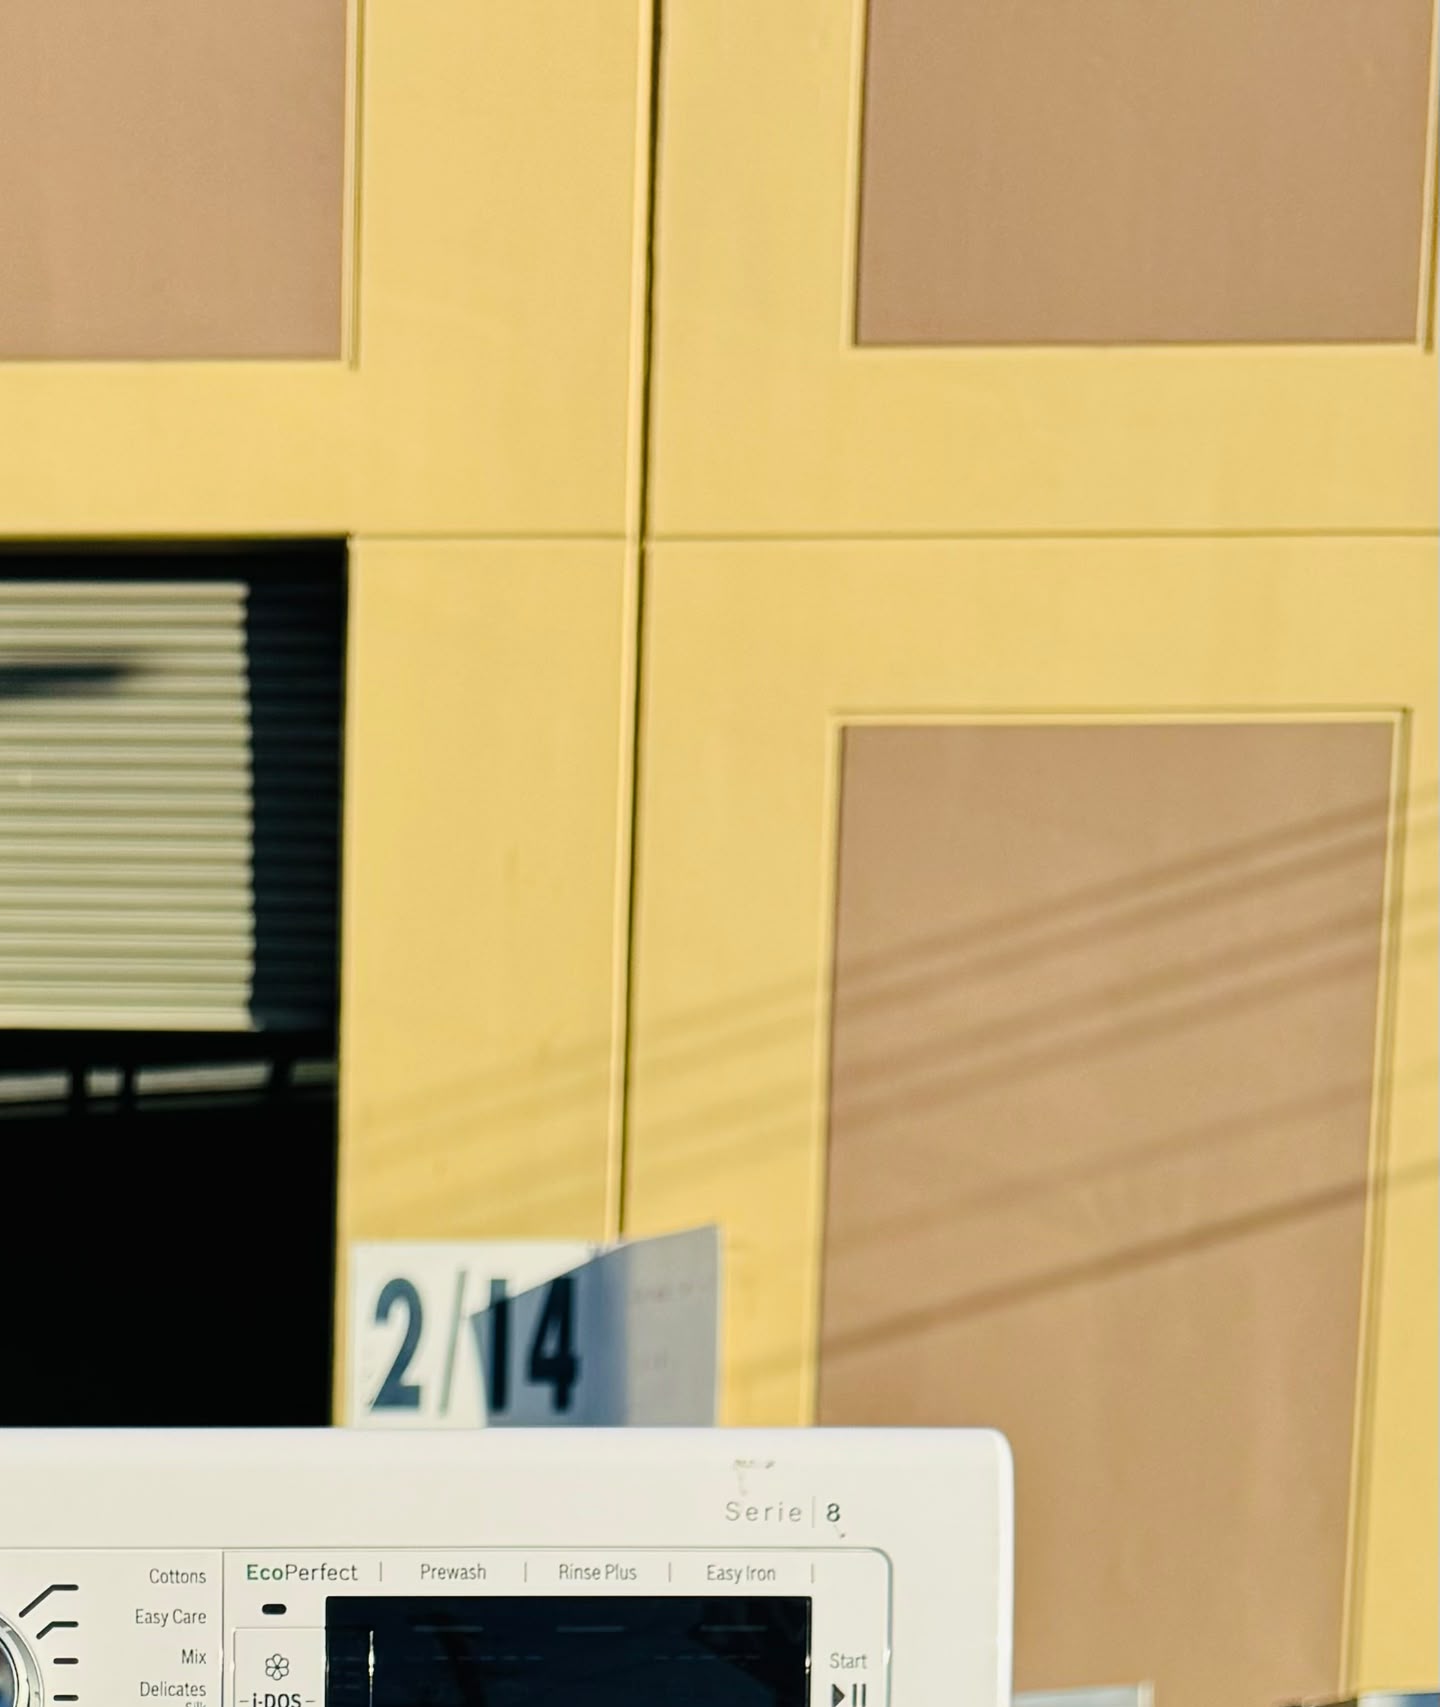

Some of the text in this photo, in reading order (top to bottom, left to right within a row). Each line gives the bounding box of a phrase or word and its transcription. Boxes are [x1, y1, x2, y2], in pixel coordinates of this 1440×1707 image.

[369, 1270, 580, 1418] 2/14
[726, 1502, 840, 1522] Serie 8
[149, 1569, 206, 1584] Cottons
[247, 1563, 358, 1580] EcoPerfect
[420, 1563, 486, 1579] Prewash
[559, 1564, 637, 1580] Rinse Plus
[707, 1565, 775, 1584] Easy Iron
[135, 1610, 206, 1627] Easy Care
[182, 1649, 206, 1664] Mix
[830, 1652, 867, 1669] Start
[140, 1682, 206, 1696] Delicates
